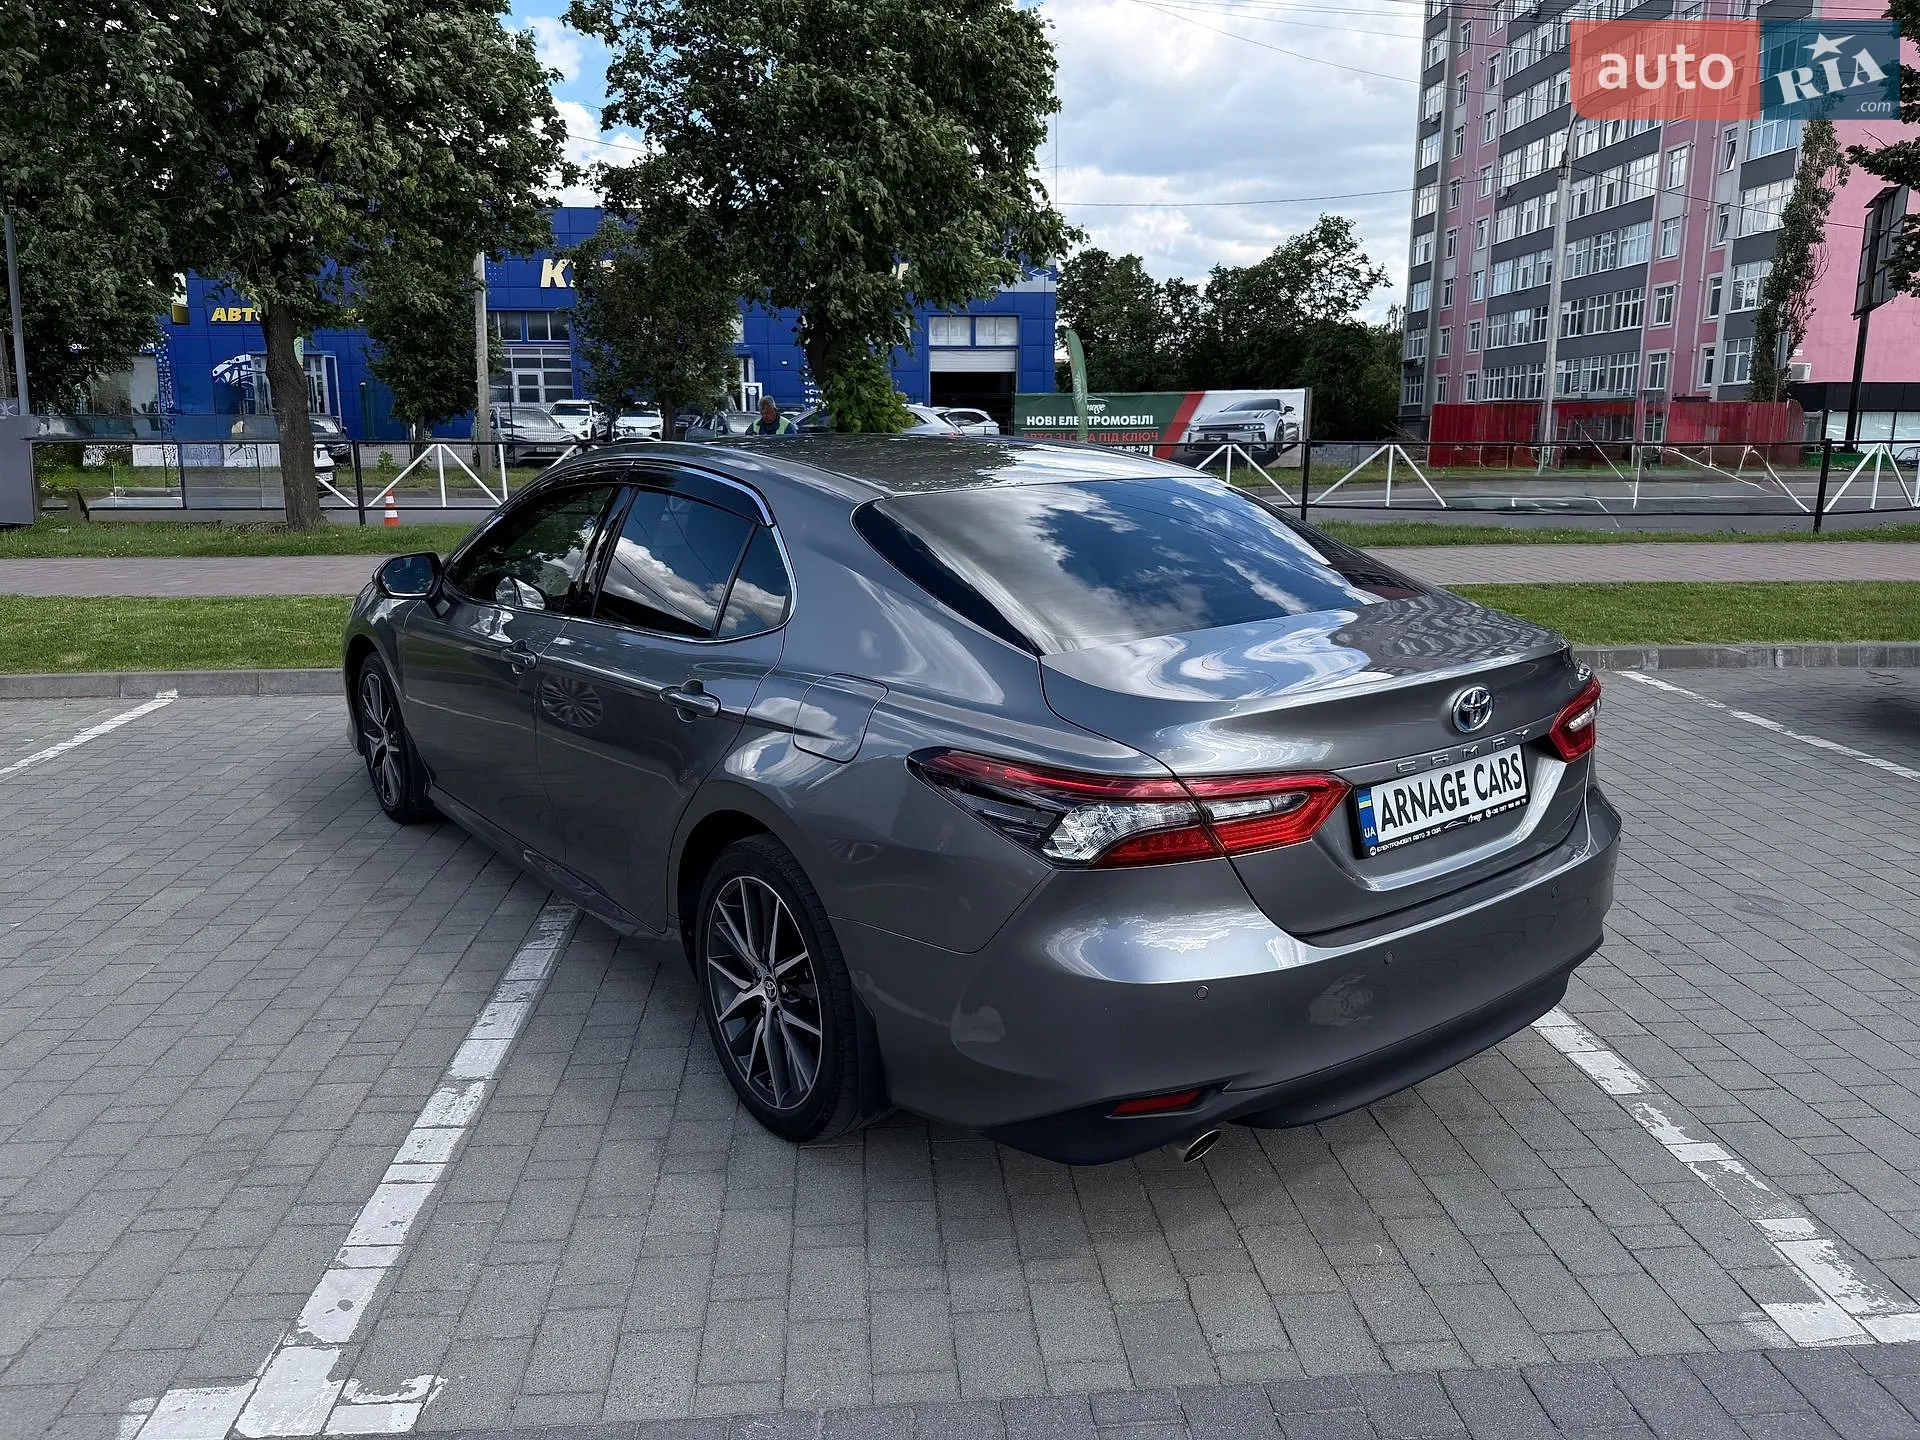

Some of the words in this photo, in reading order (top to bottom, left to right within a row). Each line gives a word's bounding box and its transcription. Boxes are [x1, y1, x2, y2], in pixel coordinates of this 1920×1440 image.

[1026, 416, 1056, 426] НОВІ
[1058, 415, 1154, 426] ЕЛЕТРОМОБІЛІ
[1068, 432, 1096, 442] СА
[1098, 432, 1120, 443] ПІД
[1122, 431, 1159, 442] КЛЮЧ
[1396, 728, 1529, 773] CAMRY
[1380, 770, 1470, 832] ARNAGE
[1473, 752, 1523, 801] CARS
[1363, 826, 1376, 839] UA
